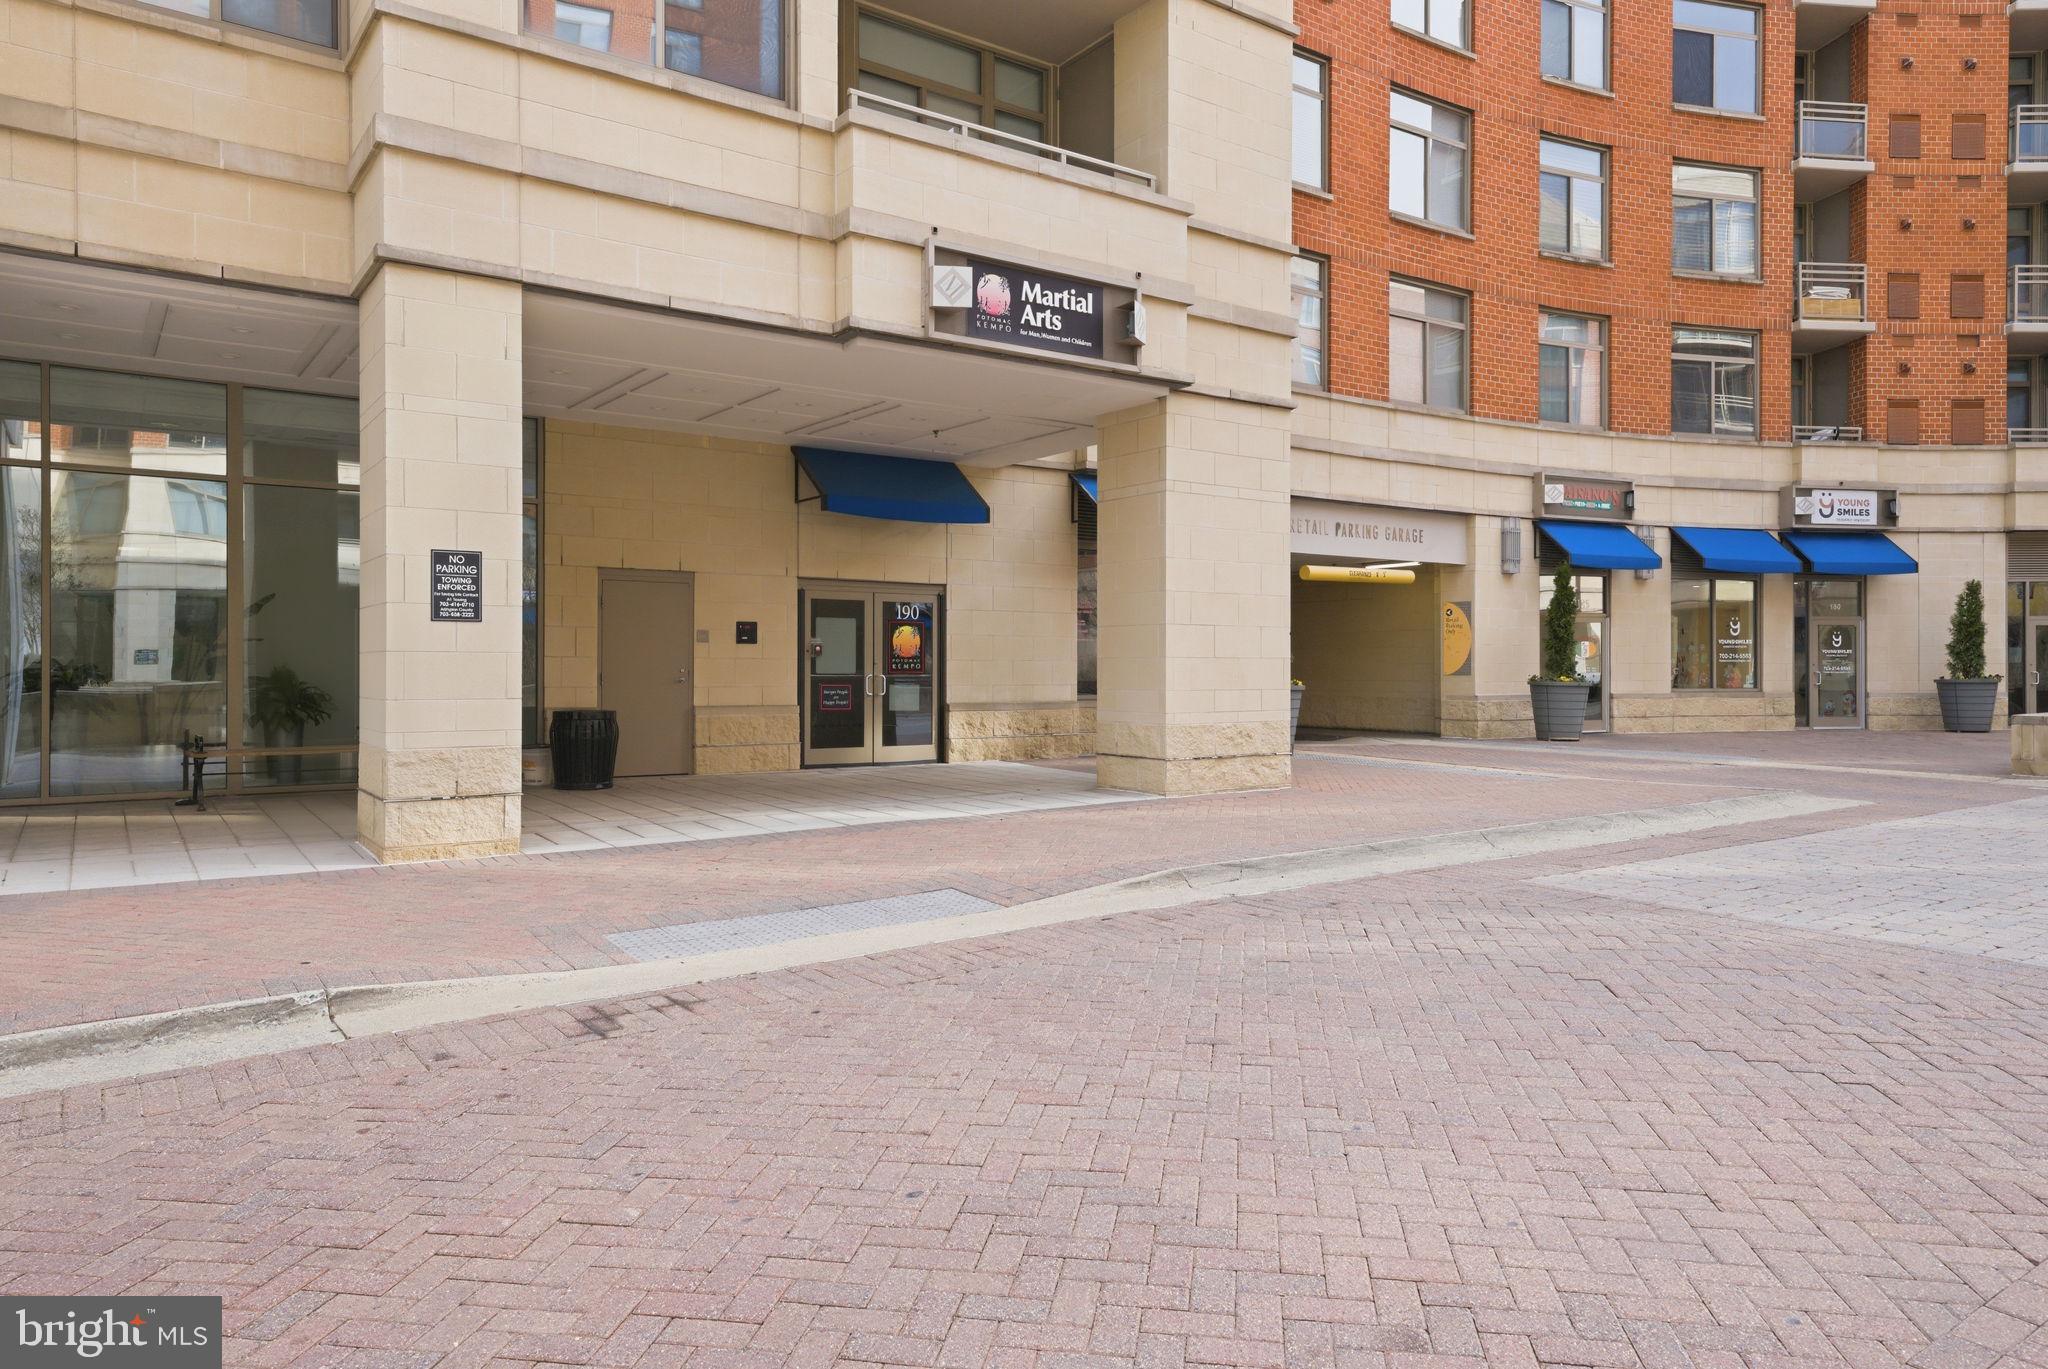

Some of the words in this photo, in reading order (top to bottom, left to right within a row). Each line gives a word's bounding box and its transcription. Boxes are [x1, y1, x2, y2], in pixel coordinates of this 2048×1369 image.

[1021, 280, 1093, 314] Martial
[976, 314, 1011, 325] POTOMAC
[1020, 304, 1062, 331] Arts
[976, 321, 1012, 333] KEMPO
[1071, 338, 1092, 347] Children
[1837, 498, 1870, 507] YOUNG
[1837, 508, 1870, 516] SMILES
[1335, 522, 1378, 540] PARKING
[1385, 526, 1424, 543] GARAGE
[449, 555, 465, 564] NO
[436, 564, 477, 574] PARKING
[437, 583, 476, 591] ENFORCED
[896, 604, 920, 620] 190
